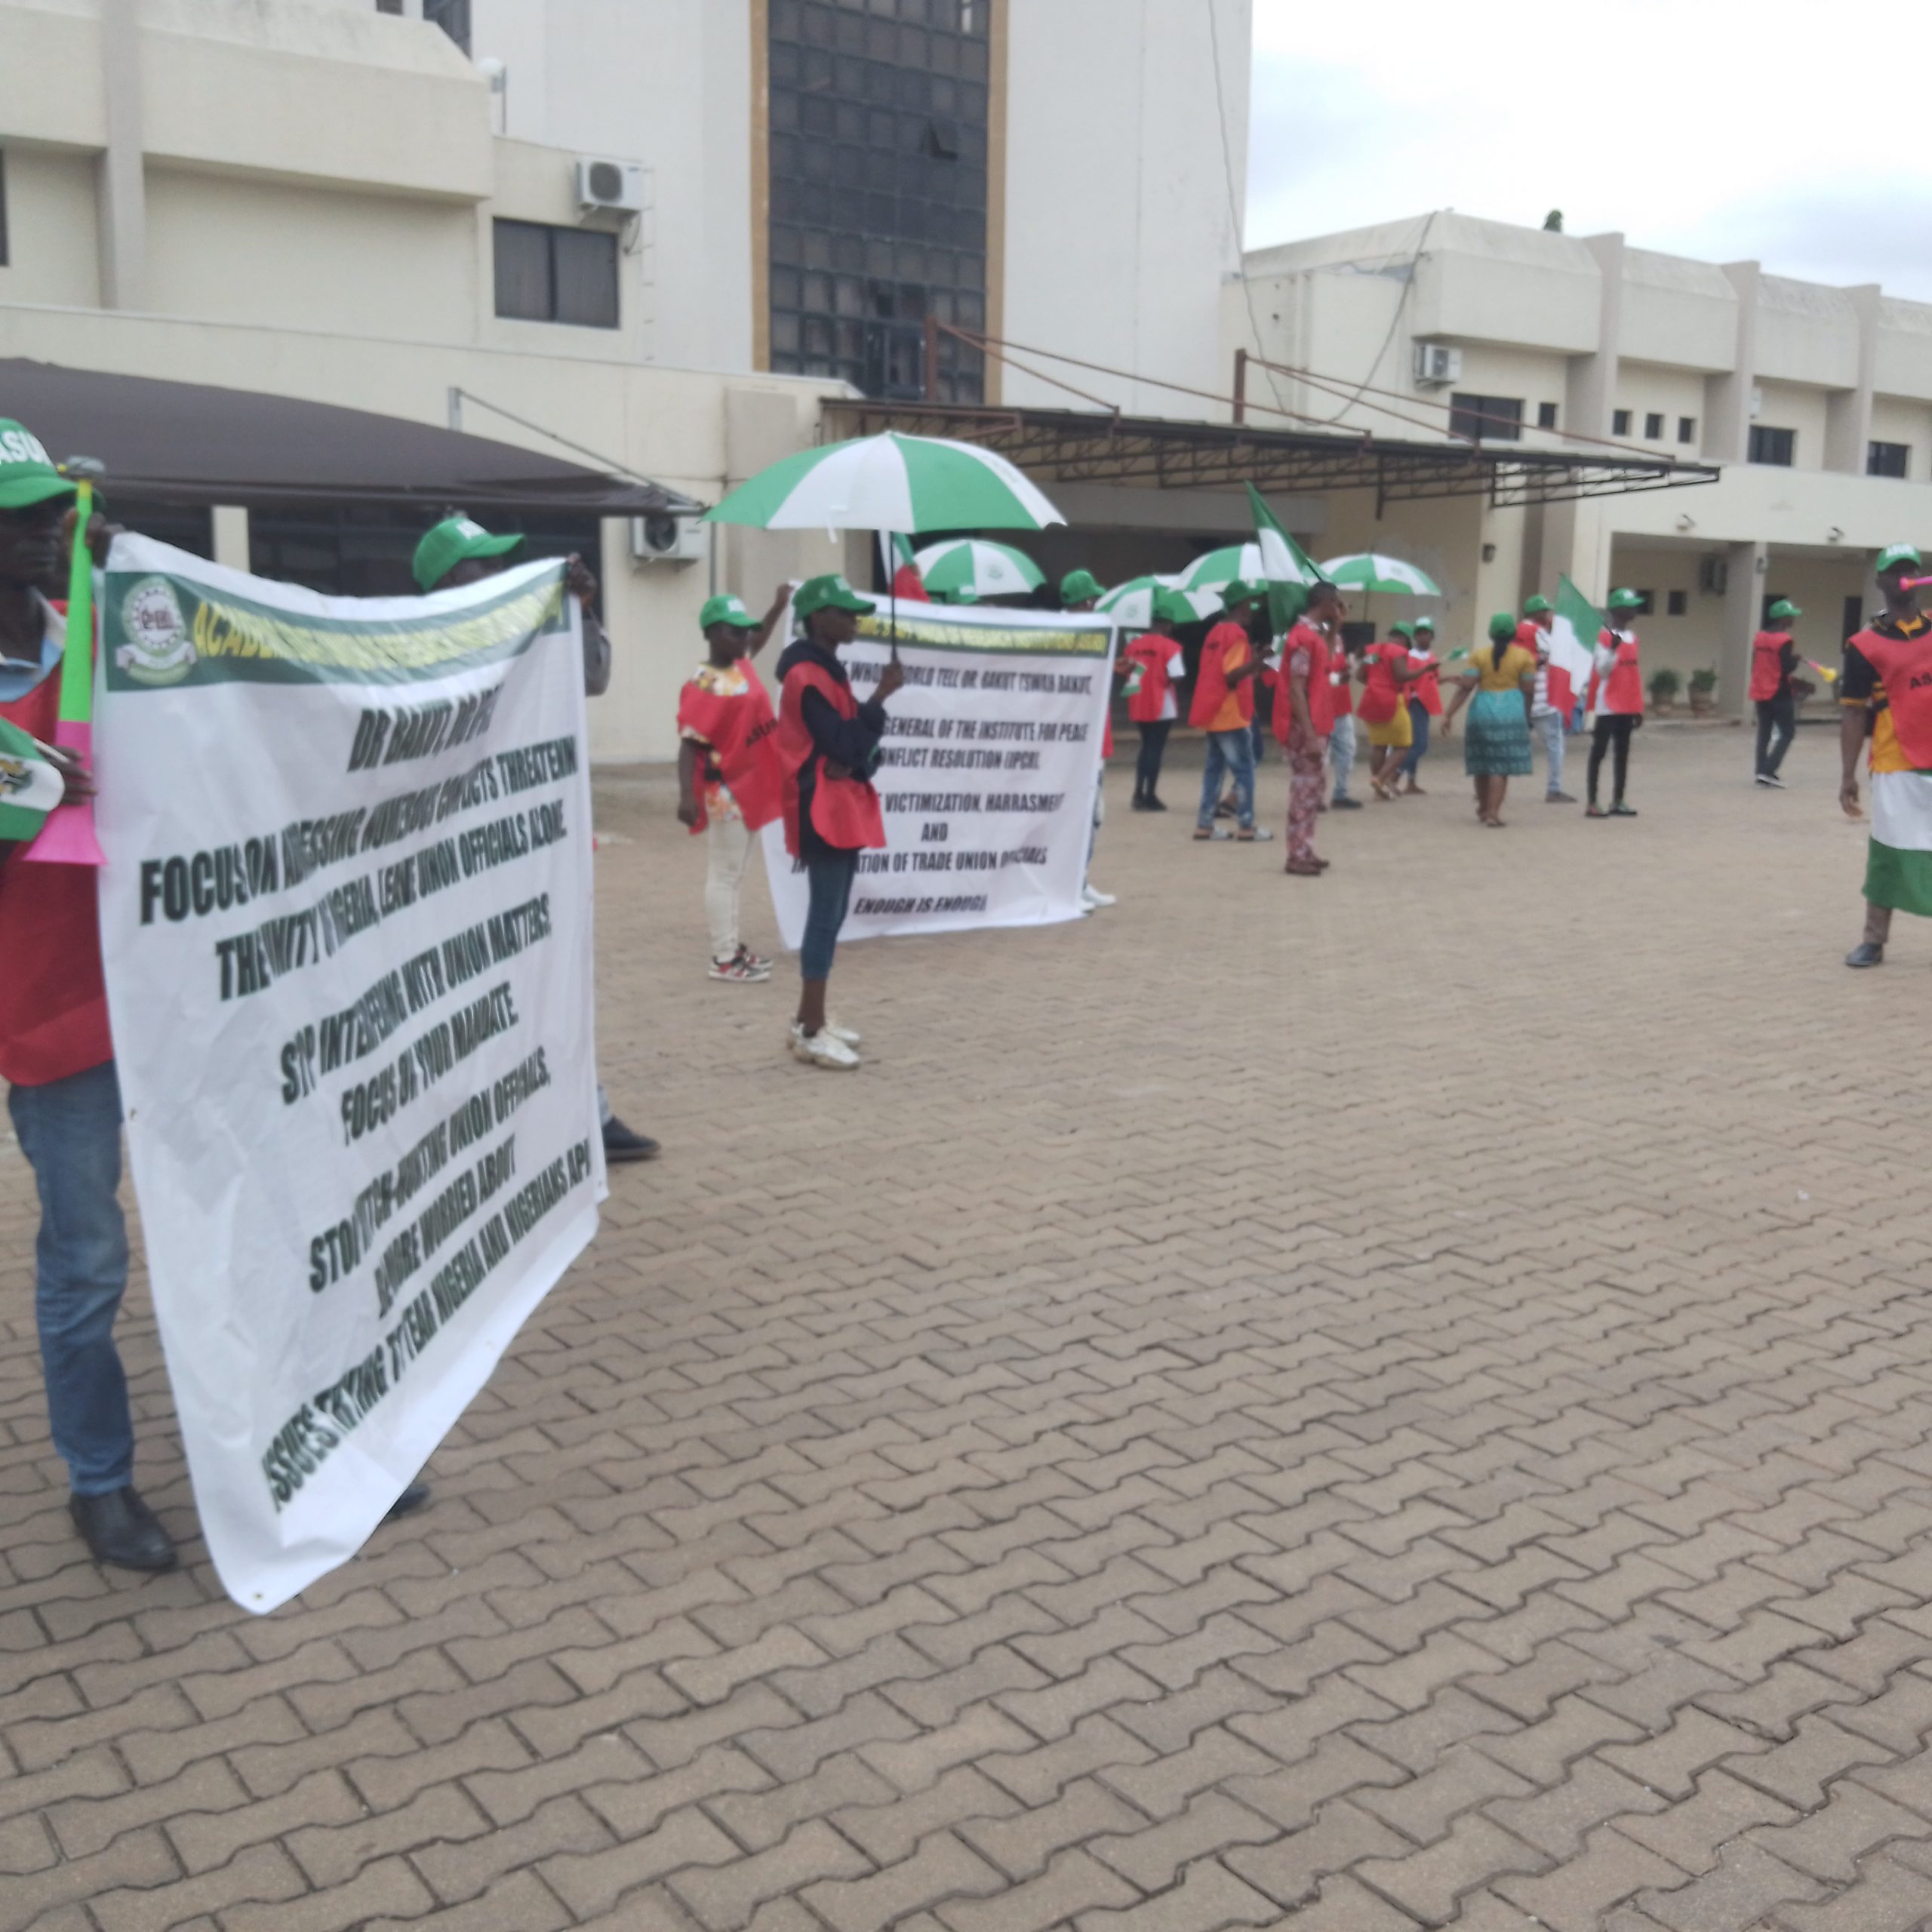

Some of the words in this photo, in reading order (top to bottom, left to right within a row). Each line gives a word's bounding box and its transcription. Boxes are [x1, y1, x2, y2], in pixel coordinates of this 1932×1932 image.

[880, 746, 928, 768] ONFLICT
[920, 822, 949, 842] AND
[892, 852, 909, 872] OF
[912, 851, 953, 872] TRADE
[955, 851, 998, 871] UNION
[140, 841, 249, 927] FOCUS
